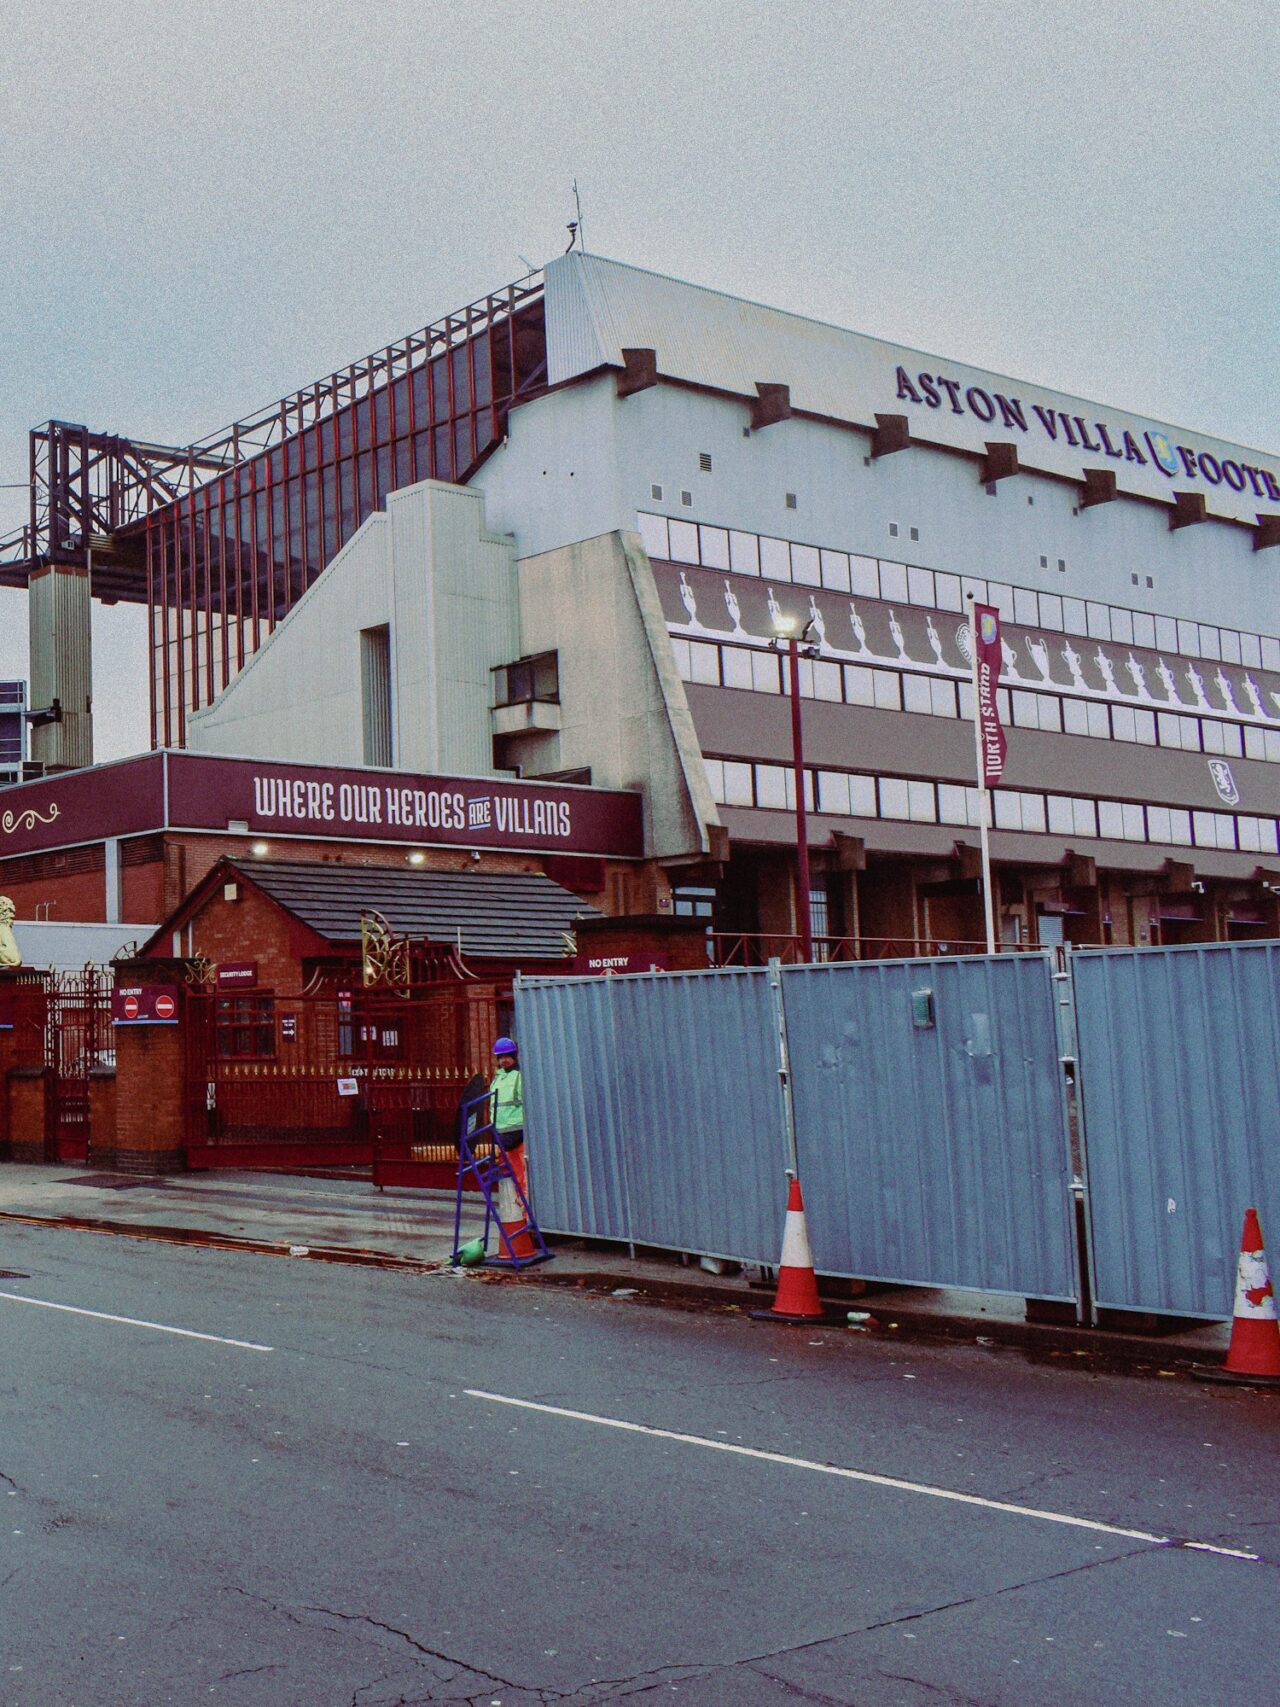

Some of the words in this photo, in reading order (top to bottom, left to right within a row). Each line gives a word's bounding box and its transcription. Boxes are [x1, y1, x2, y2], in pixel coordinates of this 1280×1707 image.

[895, 365, 1028, 432] ASTON
[1031, 404, 1148, 465] VILLA
[980, 662, 995, 717] STAND
[984, 721, 1002, 777] NORTH
[253, 777, 335, 820] WHERE
[339, 783, 382, 824] OUR
[385, 787, 465, 829] HEROES
[469, 800, 491, 826] ARE
[494, 796, 570, 837] VILLANS
[589, 959, 601, 968] NO
[602, 957, 629, 967] ENTRY
[120, 988, 127, 996] NO
